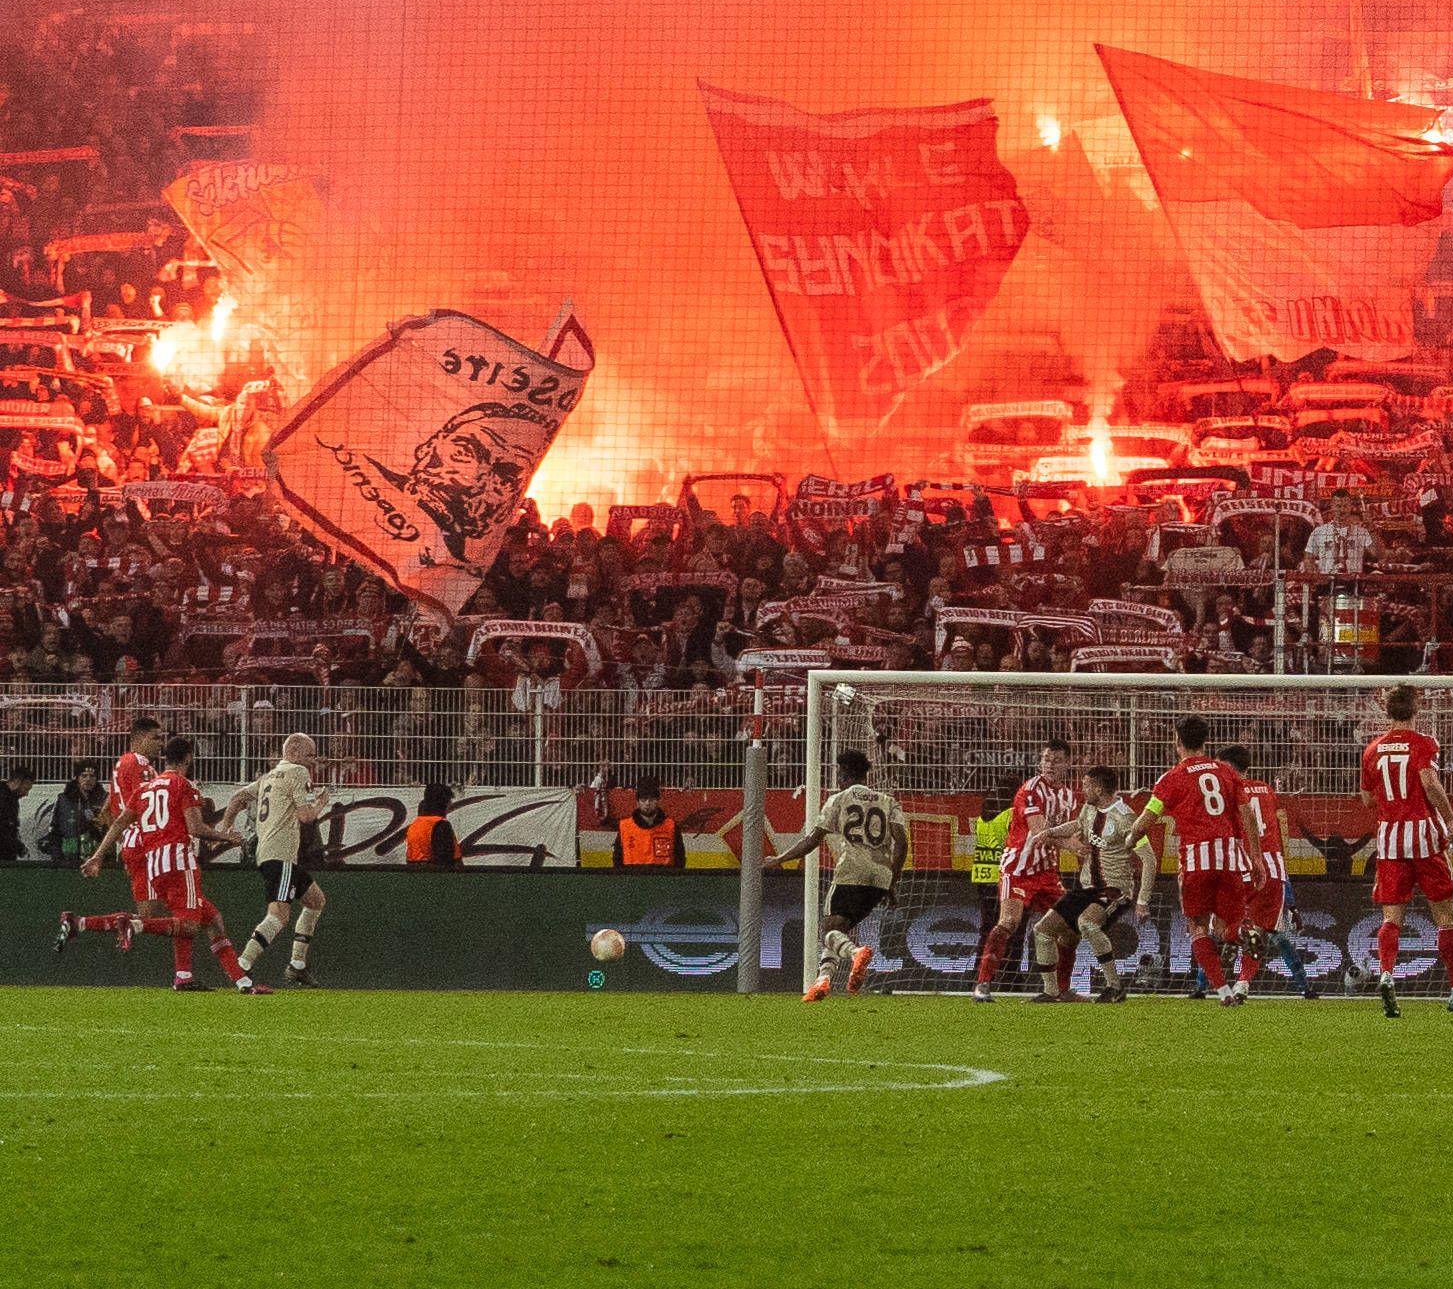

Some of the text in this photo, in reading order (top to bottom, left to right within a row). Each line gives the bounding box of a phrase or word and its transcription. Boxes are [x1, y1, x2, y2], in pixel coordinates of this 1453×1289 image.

[500, 623, 534, 634] UNION
[536, 624, 571, 635] BERLIN
[1198, 772, 1225, 816] 8
[1376, 754, 1410, 802] 17
[140, 789, 169, 832] 20
[844, 804, 887, 848] 20
[974, 850, 1002, 863] EWAR
